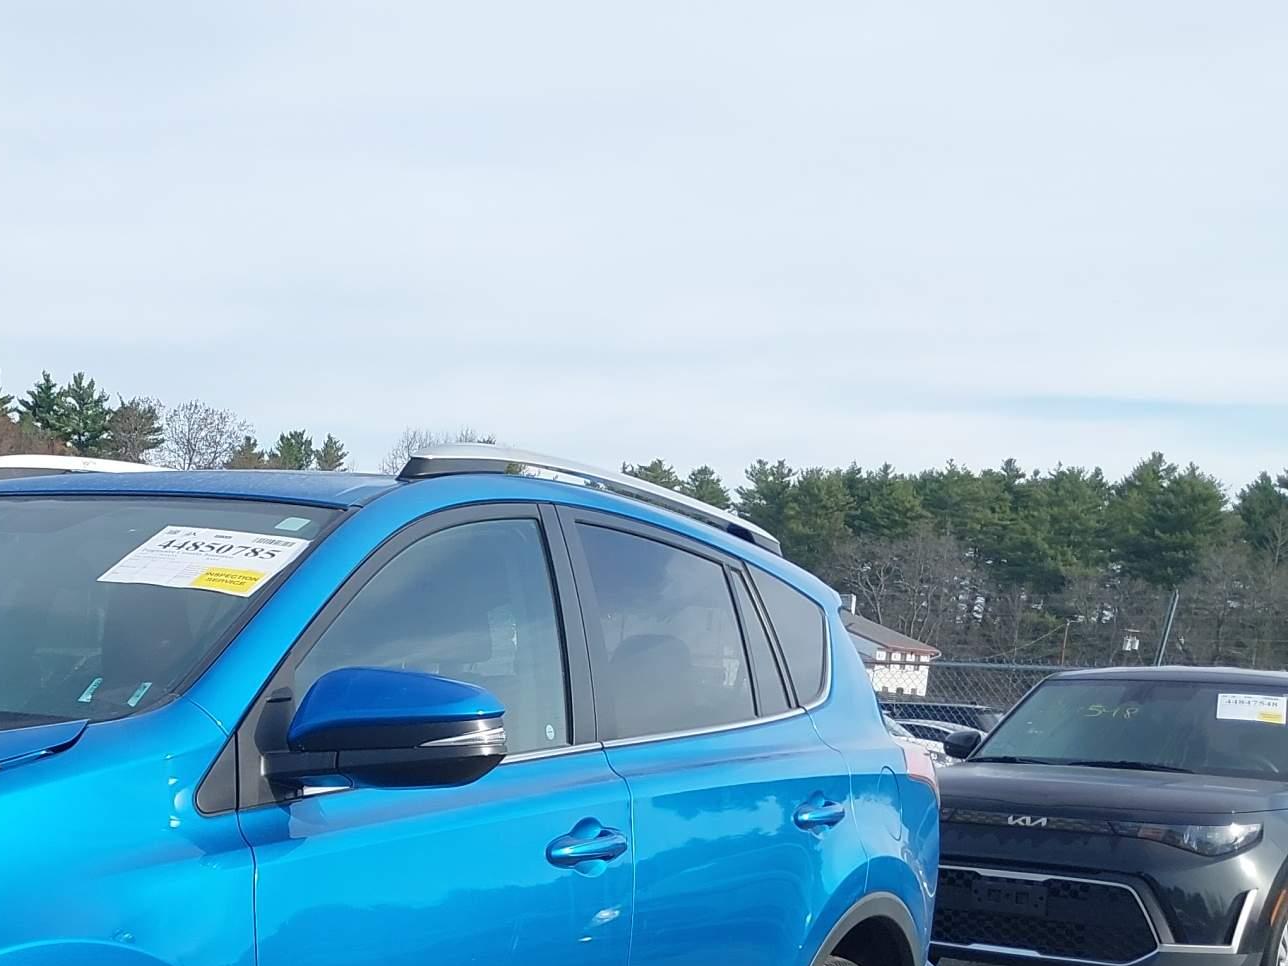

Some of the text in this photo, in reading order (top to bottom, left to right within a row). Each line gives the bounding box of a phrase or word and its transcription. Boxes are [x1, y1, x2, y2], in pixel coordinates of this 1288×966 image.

[158, 539, 282, 560] 44850785
[205, 571, 260, 583] INSPECTION
[206, 577, 248, 586] SERVICE
